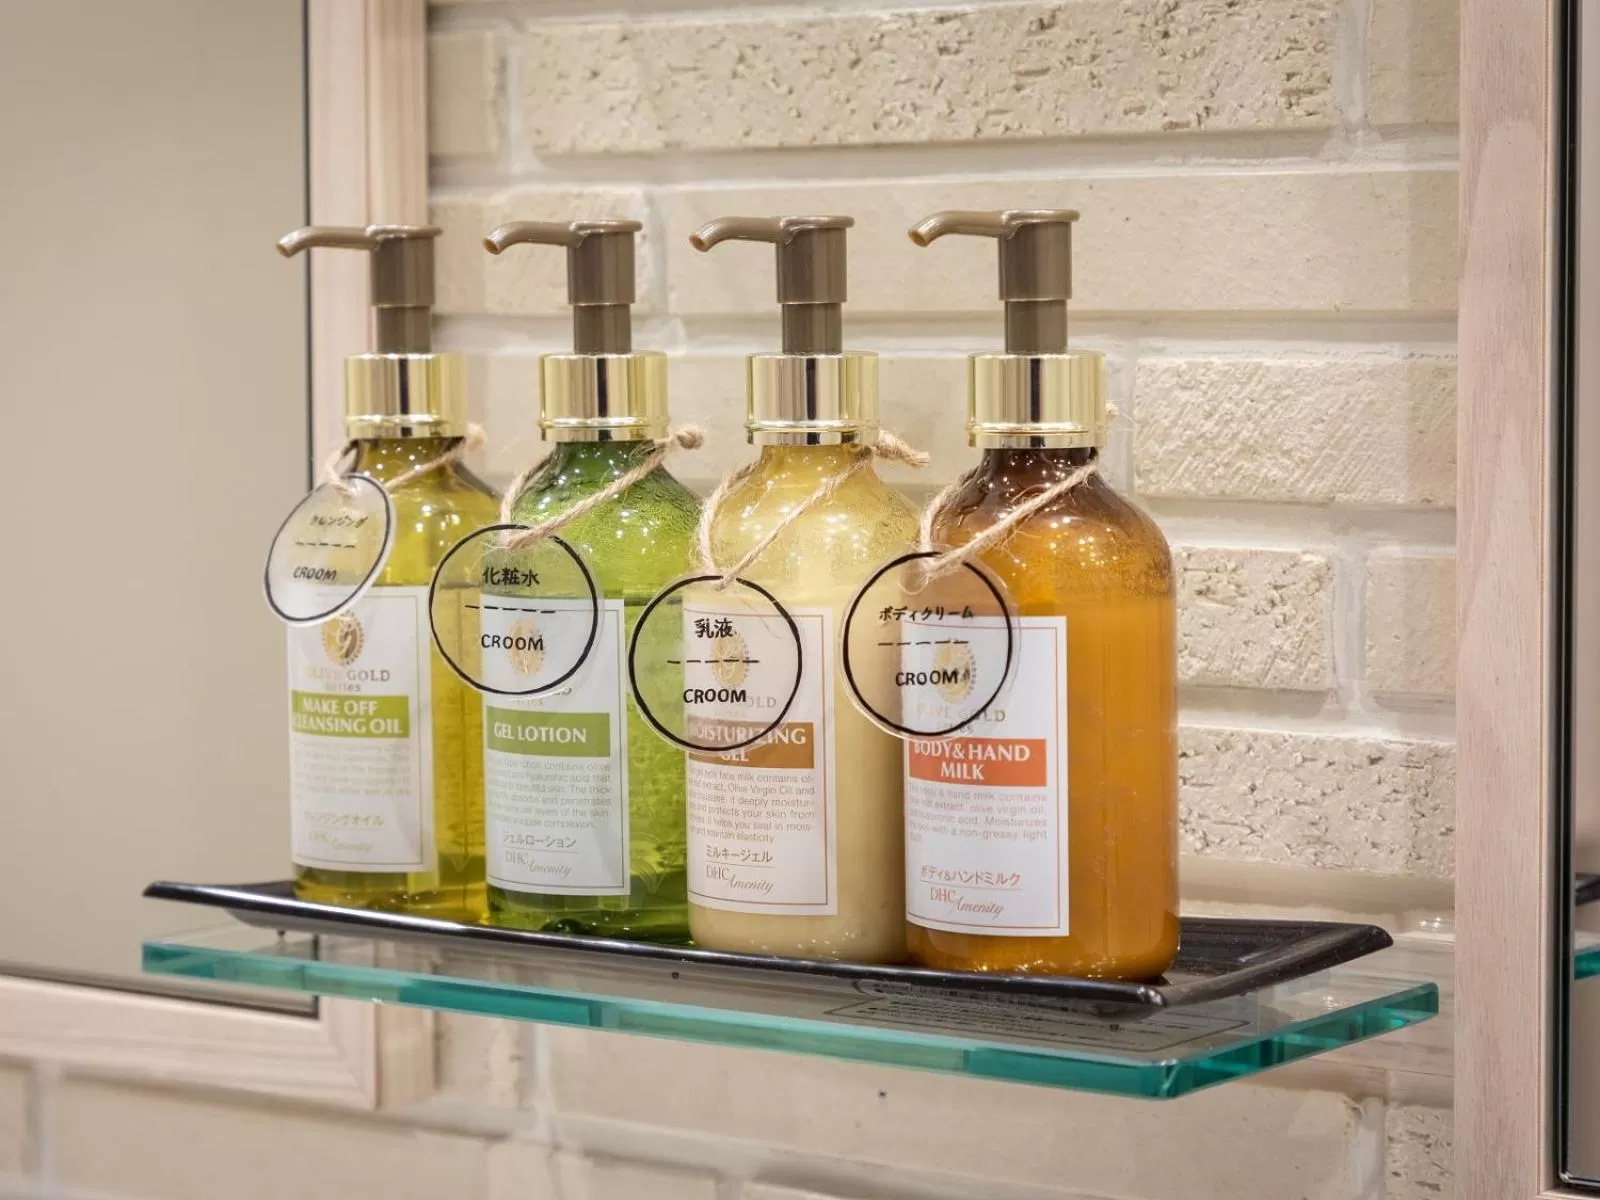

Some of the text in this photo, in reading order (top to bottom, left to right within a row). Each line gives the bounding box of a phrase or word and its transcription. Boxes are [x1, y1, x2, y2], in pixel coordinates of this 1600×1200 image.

[292, 565, 338, 581] CROOM
[482, 566, 540, 587] 化粧水
[879, 605, 975, 623] ボディクリーム
[693, 617, 734, 639] 乳液
[480, 633, 544, 652] CROOM
[346, 668, 391, 682] GOLD
[895, 667, 960, 687] CROOM
[683, 687, 747, 705] CROOM
[302, 696, 379, 716] MAKE OFF
[368, 717, 404, 735] OIL
[493, 721, 587, 744] GEL LOTION
[940, 760, 985, 781] MILK
[706, 844, 774, 863] ミルキージェル
[705, 864, 731, 881] DHC
[728, 873, 775, 897] Amenity
[929, 886, 956, 903] DHC
[951, 895, 1005, 921] Amenity
